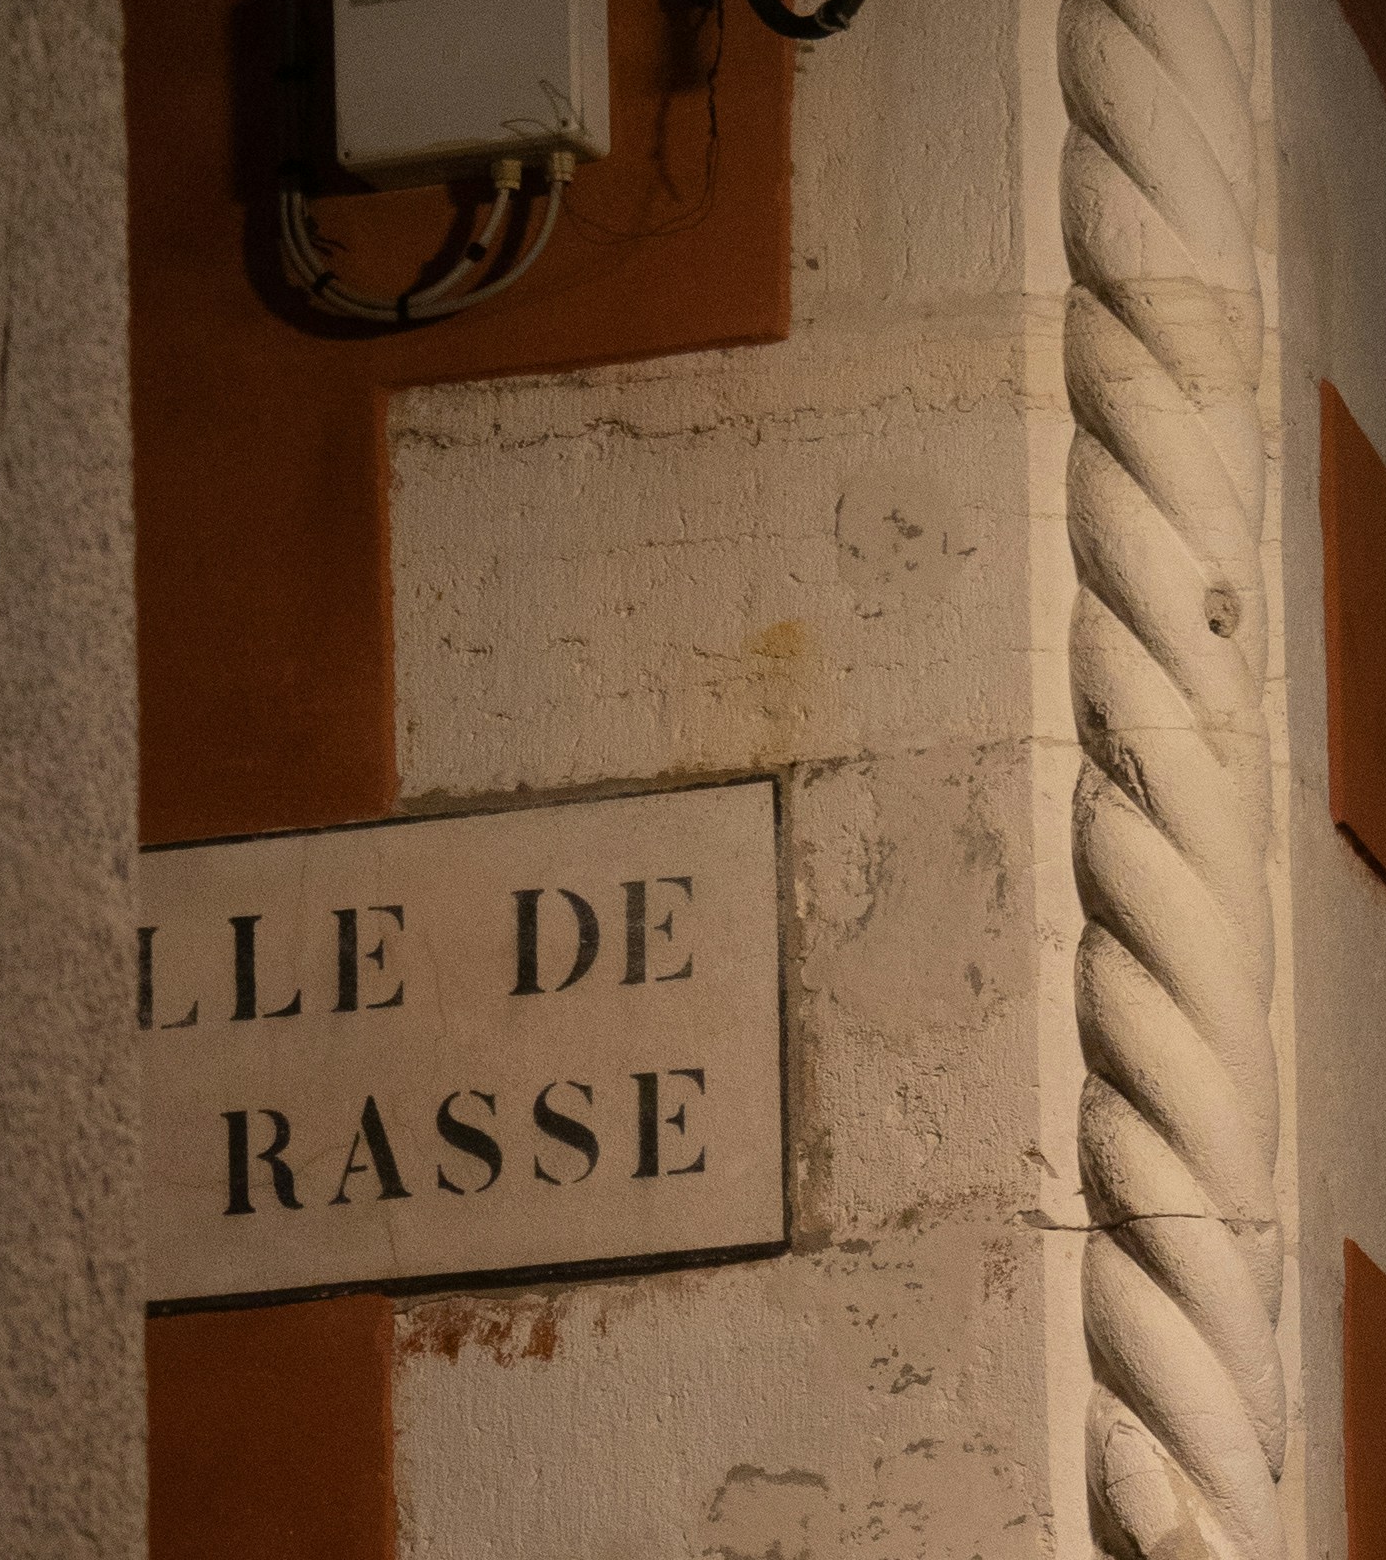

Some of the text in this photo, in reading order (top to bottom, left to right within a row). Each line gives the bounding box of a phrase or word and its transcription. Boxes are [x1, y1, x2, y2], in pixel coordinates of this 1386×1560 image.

[136, 875, 694, 1031] LLE DE
[219, 1068, 707, 1217] RASSE
